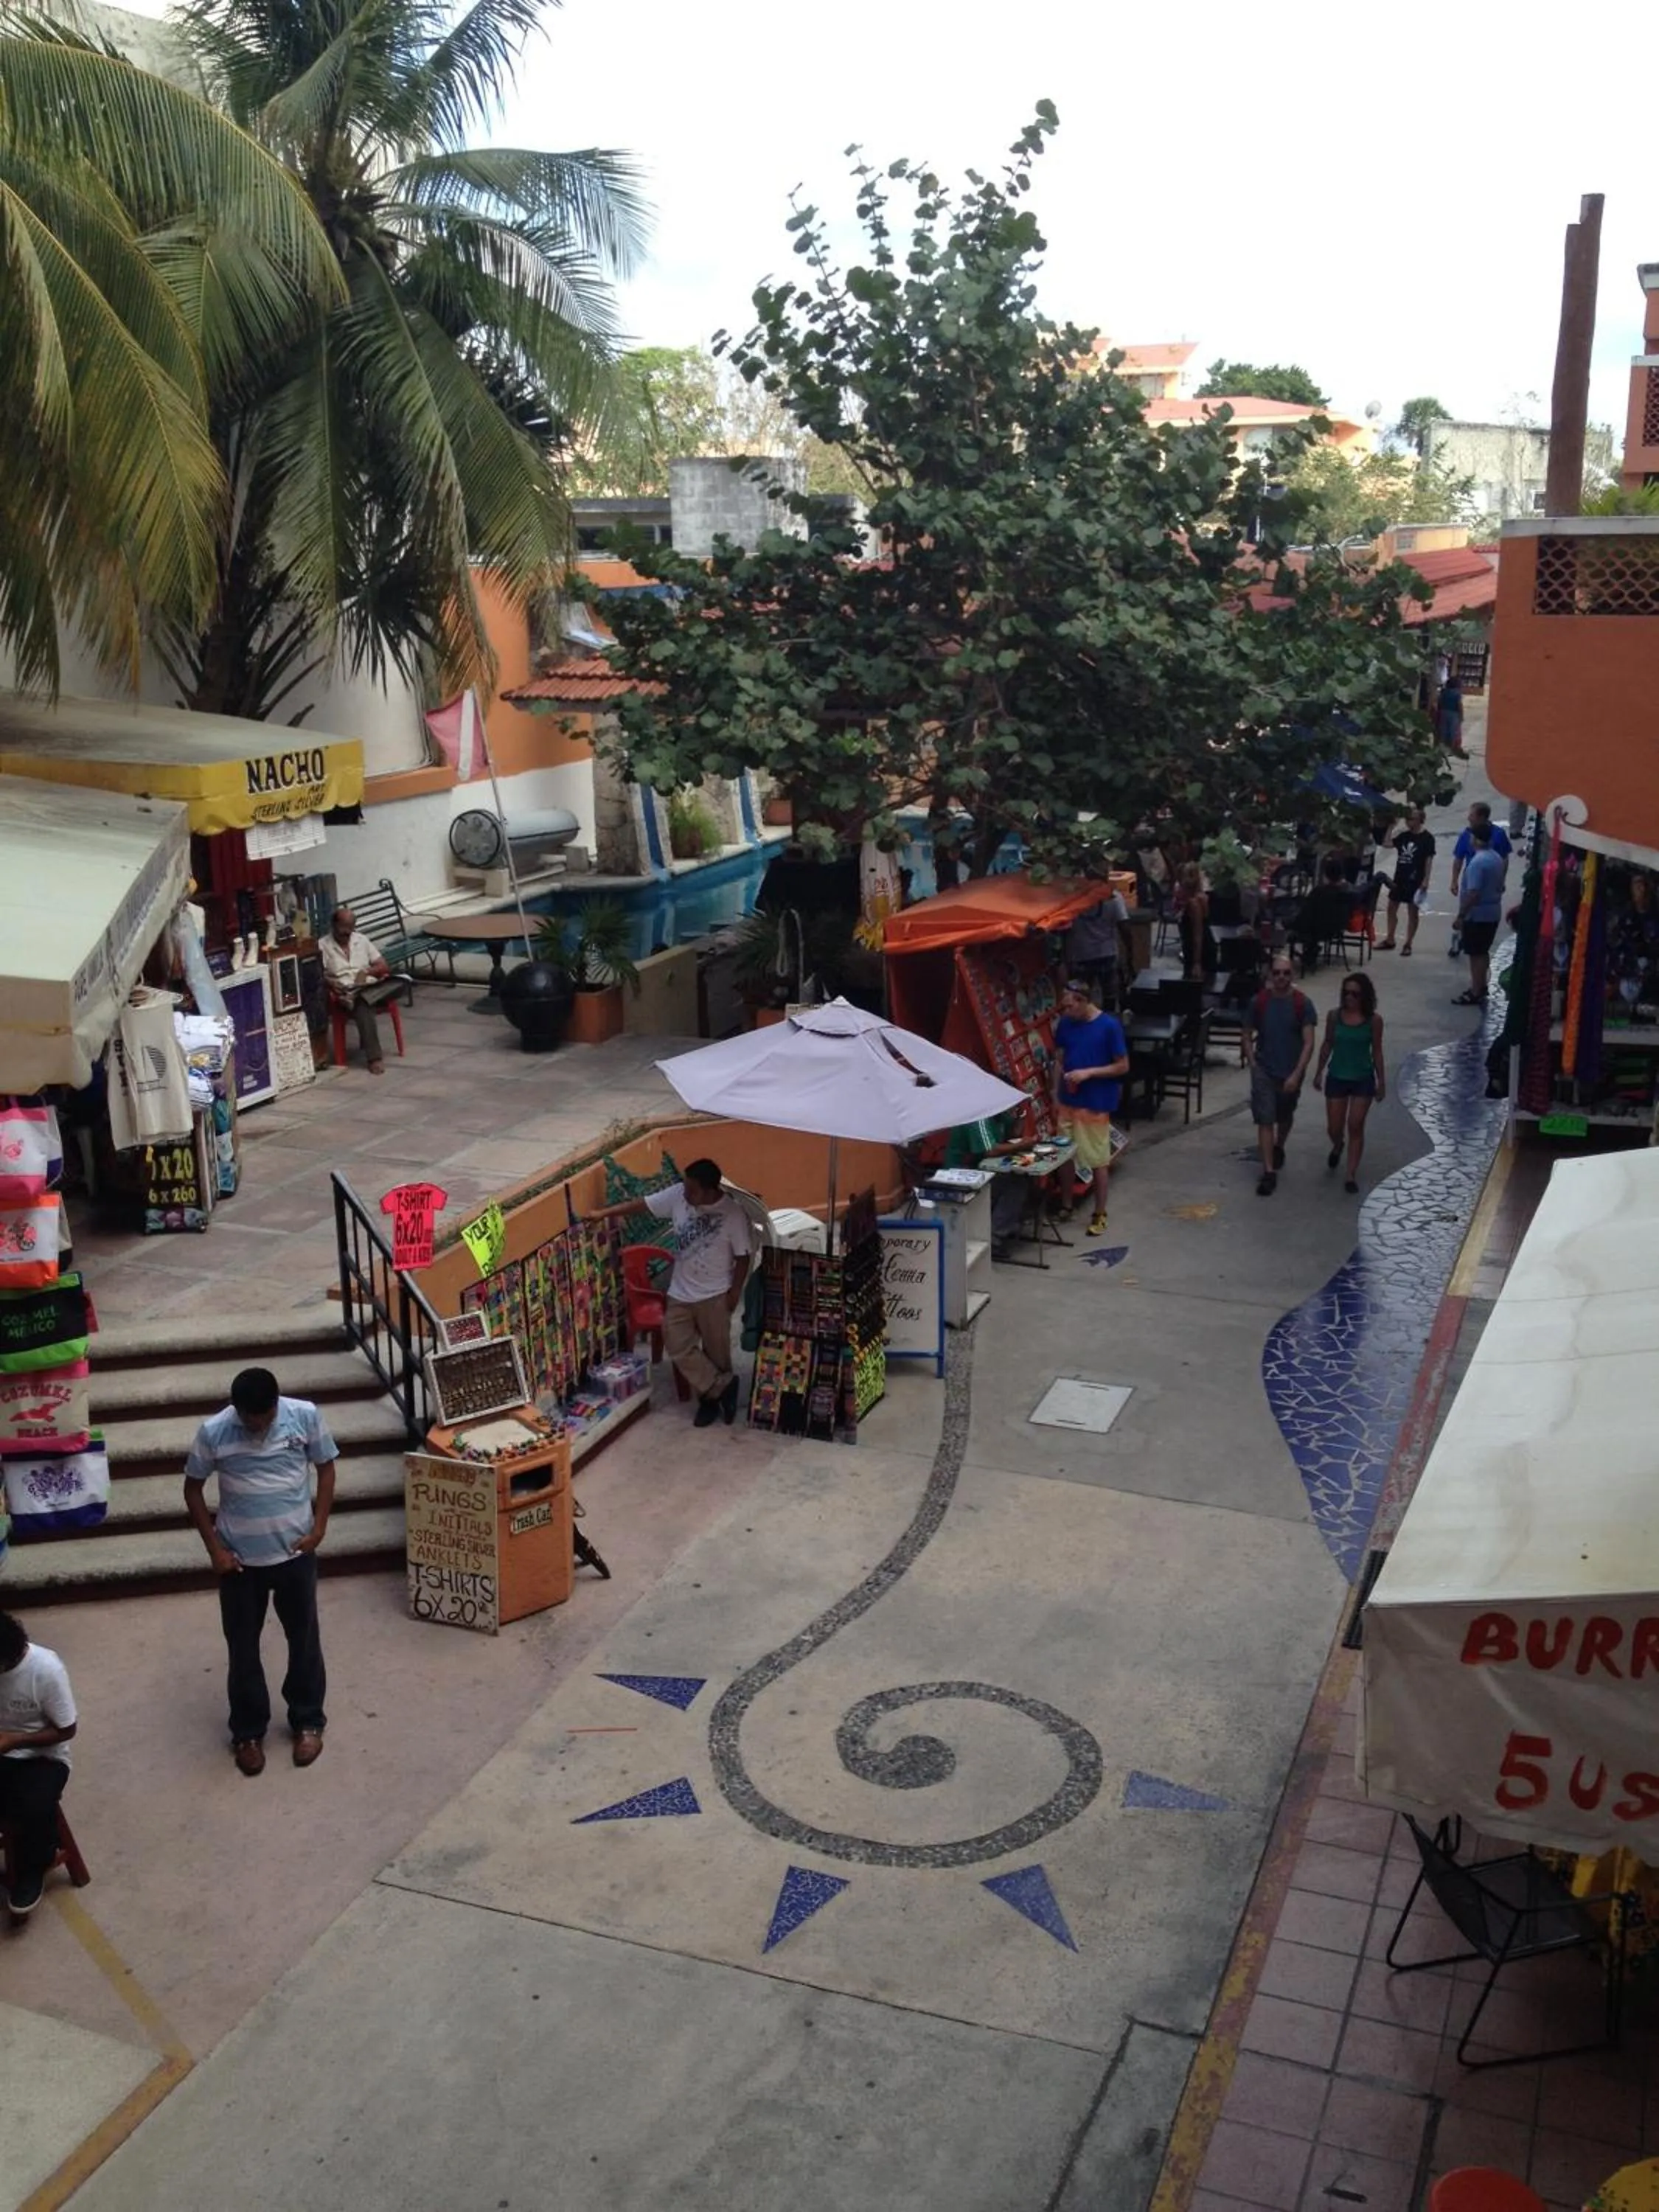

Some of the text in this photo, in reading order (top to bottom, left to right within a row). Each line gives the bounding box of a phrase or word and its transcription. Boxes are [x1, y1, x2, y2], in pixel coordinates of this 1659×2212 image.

[246, 748, 325, 794] NACHO
[396, 1191, 431, 1212] T-SHIRT
[880, 1237, 931, 1254] porary
[1, 1304, 60, 1326] COZMEL
[412, 1483, 487, 1512] RINGS
[417, 1545, 483, 1571] ANKLETS
[408, 1559, 495, 1604] T-SHIRTS
